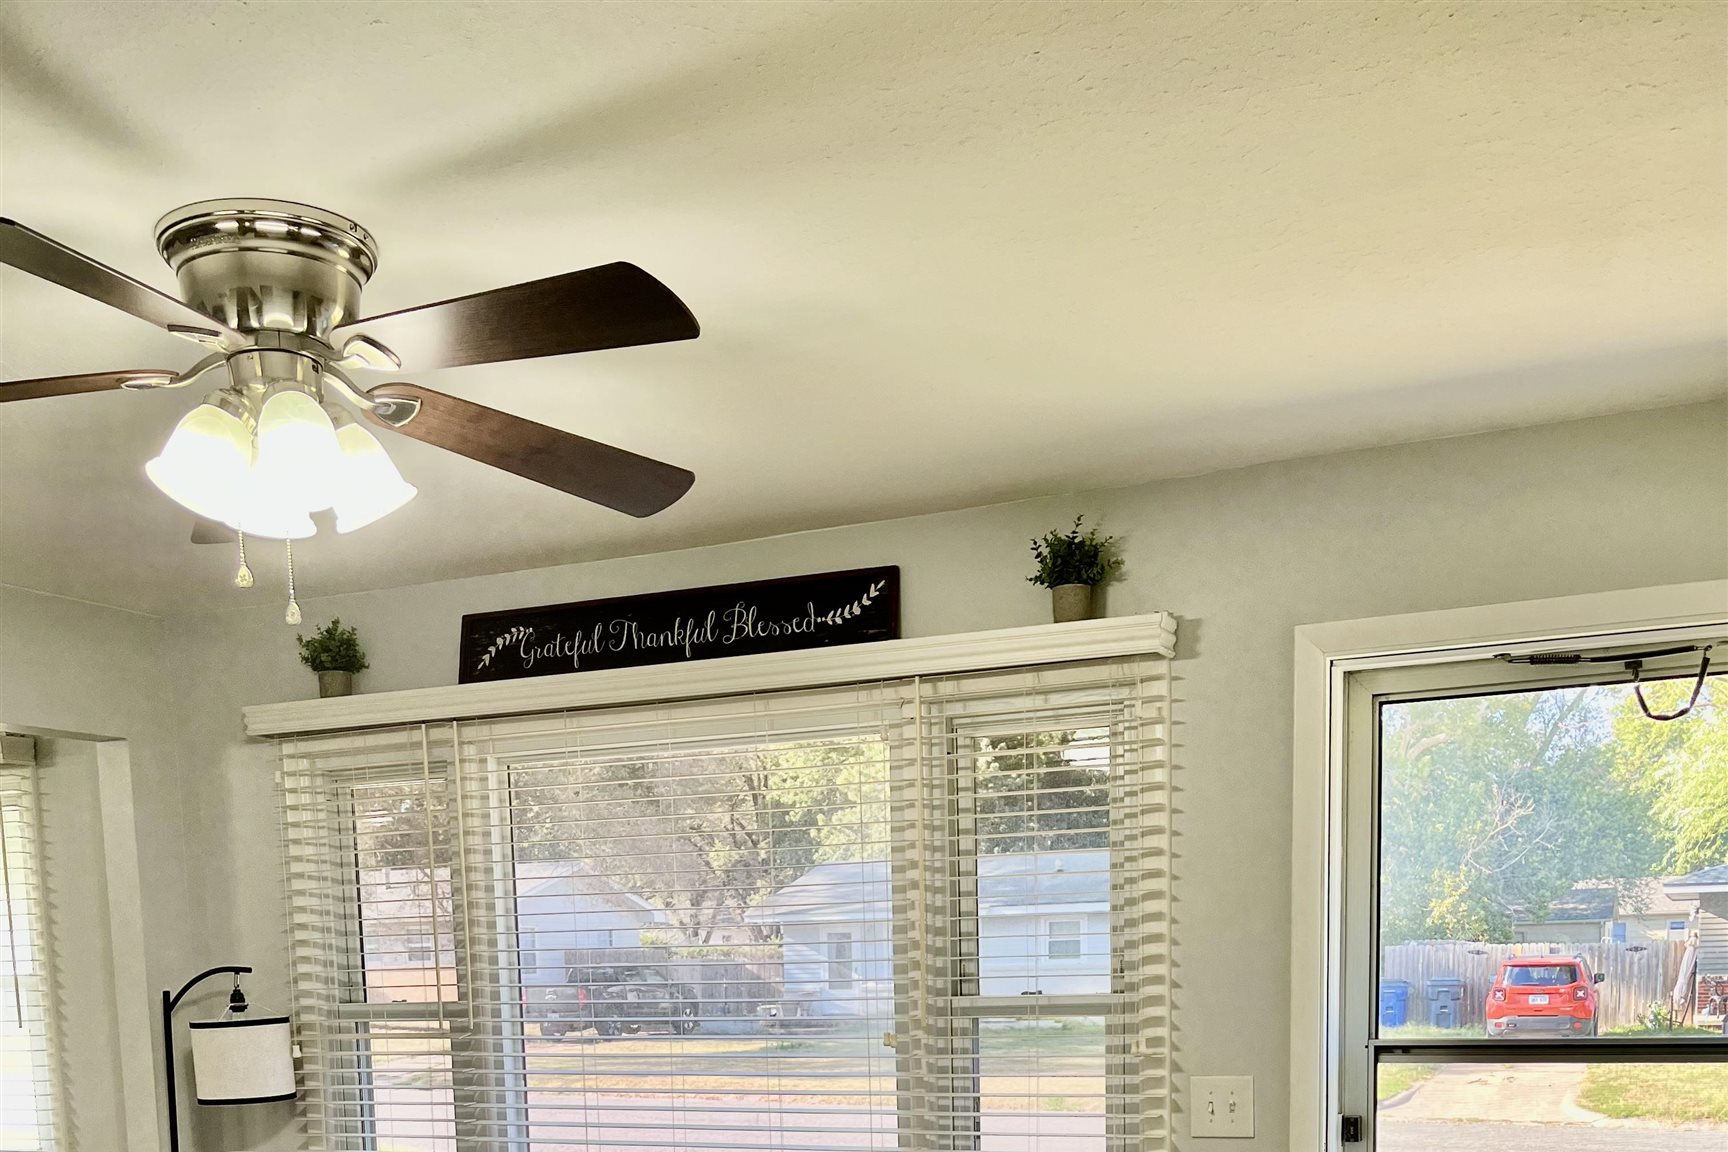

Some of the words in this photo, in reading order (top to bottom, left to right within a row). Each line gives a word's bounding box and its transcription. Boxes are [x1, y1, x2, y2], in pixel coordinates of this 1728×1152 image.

[520, 622, 605, 669] Grateful
[609, 610, 719, 658] Thankful
[722, 601, 815, 644] Blessed
